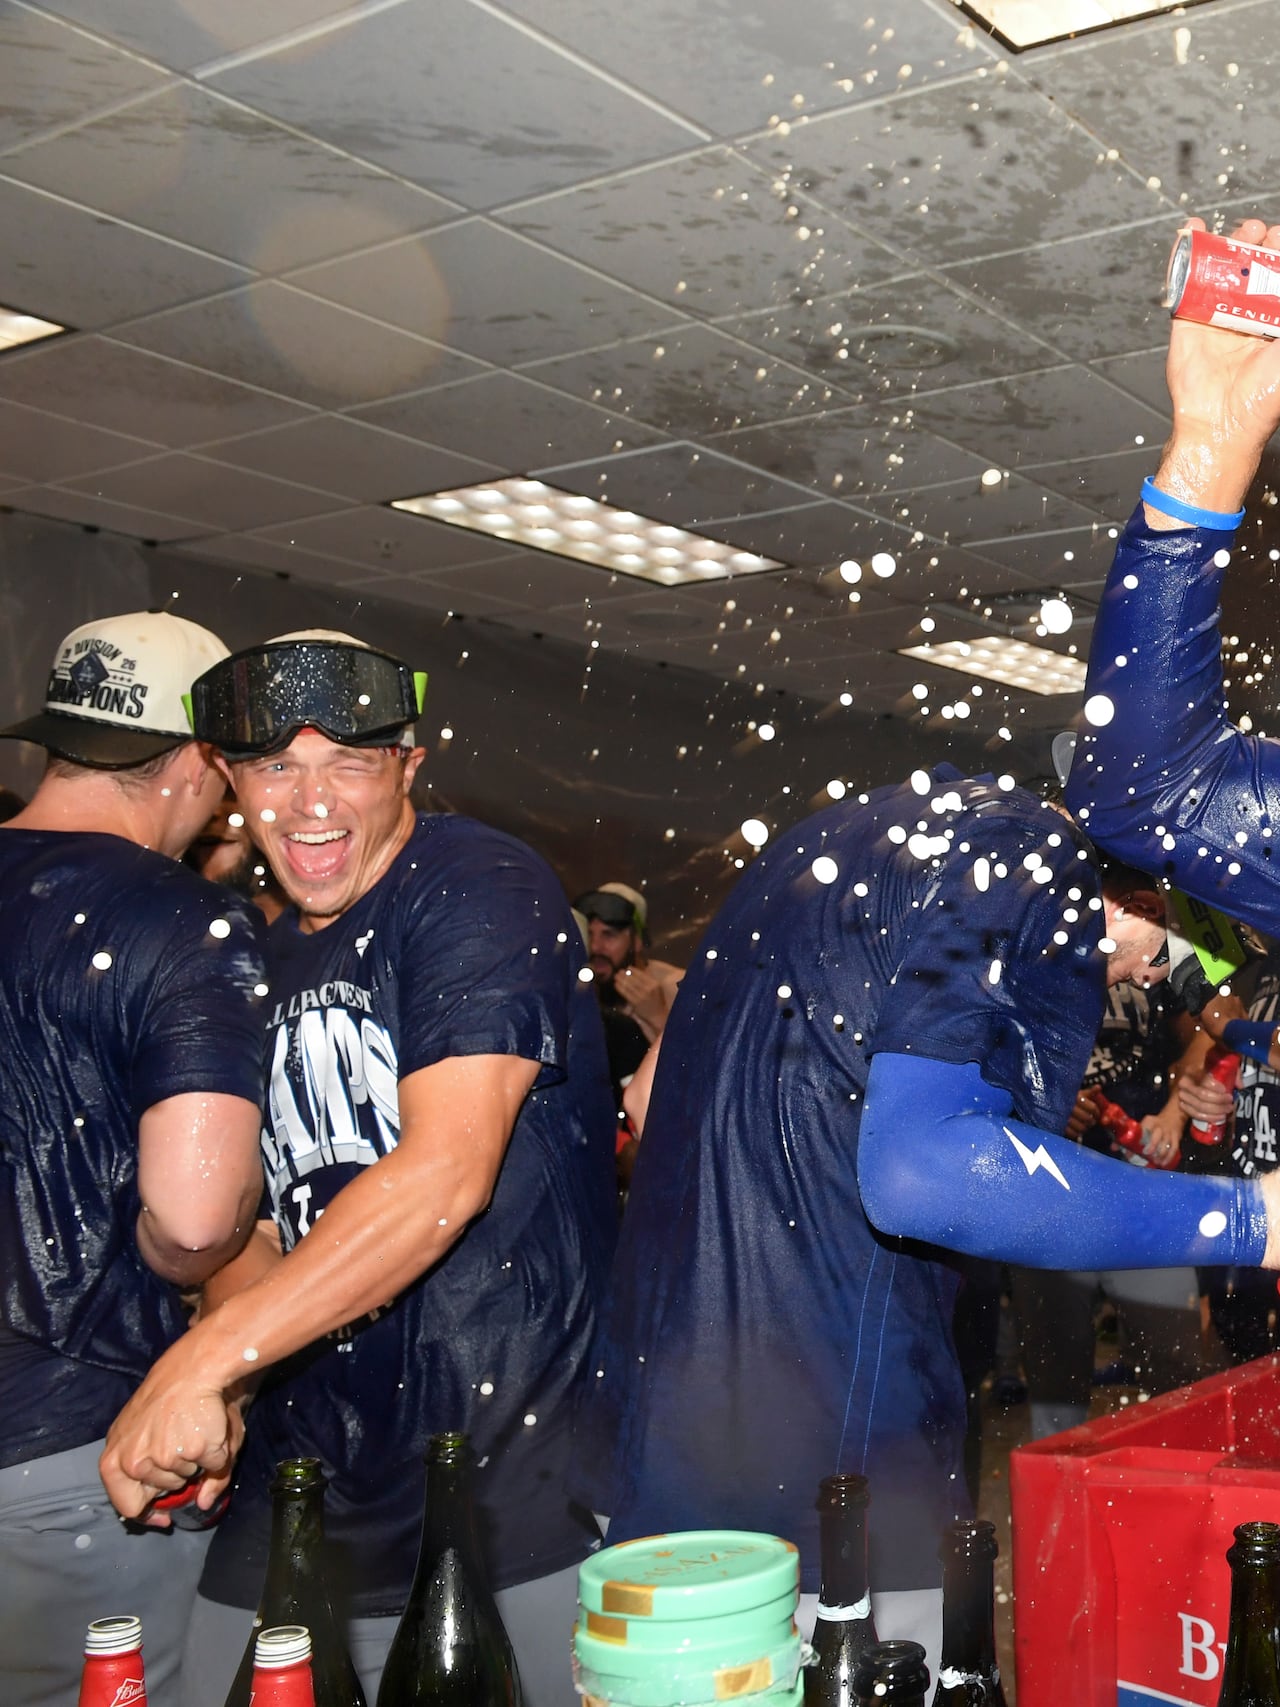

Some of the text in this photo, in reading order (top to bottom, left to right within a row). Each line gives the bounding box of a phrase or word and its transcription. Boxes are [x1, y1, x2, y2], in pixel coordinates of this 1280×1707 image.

[75, 638, 123, 661] DIVISION
[121, 658, 137, 671] 26
[261, 1008, 400, 1190] AMPS
[1253, 1087, 1278, 1162] LA
